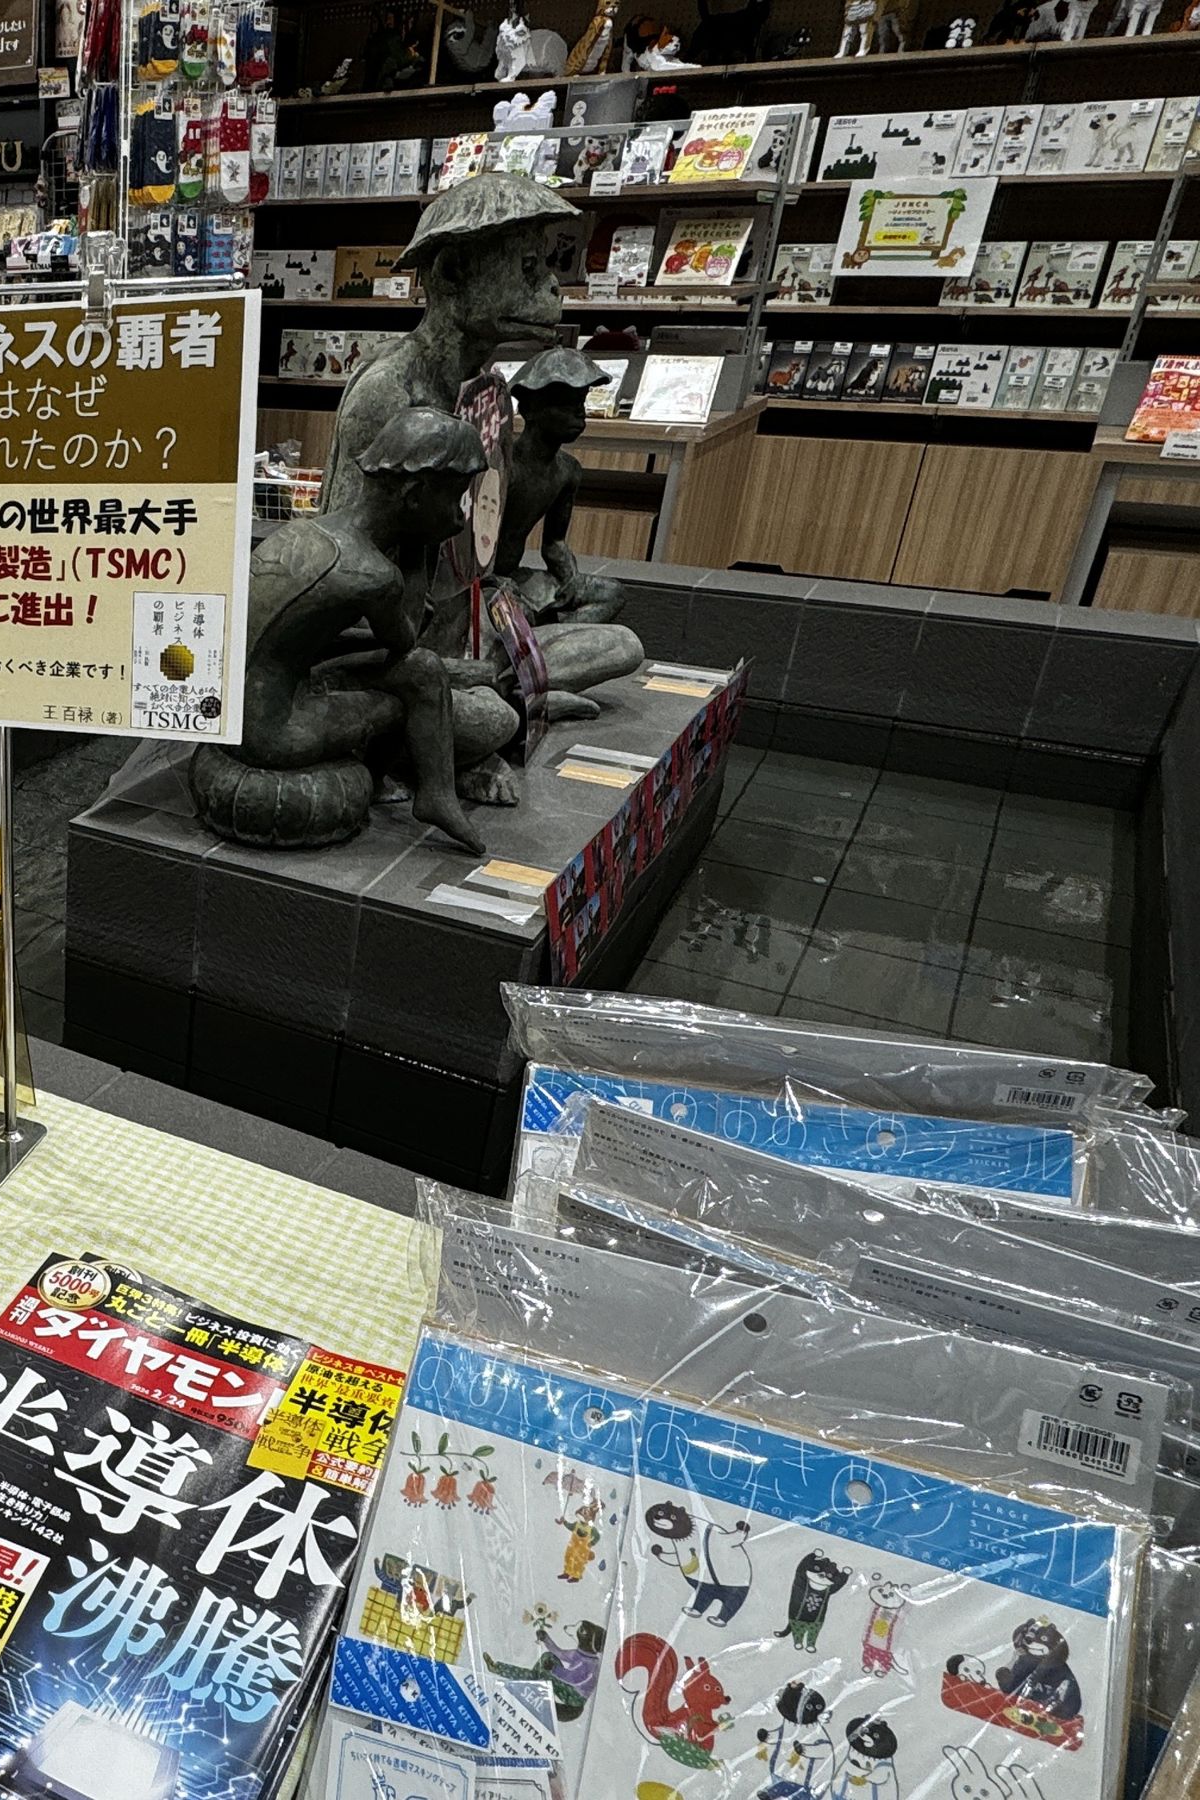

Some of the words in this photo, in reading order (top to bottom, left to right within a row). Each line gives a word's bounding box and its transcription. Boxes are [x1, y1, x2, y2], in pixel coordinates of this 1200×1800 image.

[152, 600, 165, 636] の覇者
[173, 600, 185, 645] ビジネス
[193, 600, 206, 640] 半導体
[143, 710, 209, 732] TSMC
[48, 1271, 101, 1299] 5000号
[67, 1264, 98, 1282] 創刊
[50, 1286, 81, 1305] 記念
[9, 1294, 41, 1326] 週刊
[104, 1295, 297, 1378] 丸ごと一冊「半導体」
[185, 1311, 301, 1361] ビジネス・投資に効く
[305, 1363, 384, 1393] 原油を超える
[151, 1387, 186, 1410] 2/24
[322, 1426, 387, 1465] 戦争
[971, 1500, 1029, 1523] LARGE
[41, 1541, 305, 1724] 沸騰
[345, 1649, 363, 1676] KITTA
[343, 1672, 361, 1698] KITTA
[362, 1678, 380, 1704] KITTA
[419, 1669, 439, 1697] KITTA
[438, 1675, 458, 1703] KITTA
[438, 1699, 457, 1728] KITTA
[457, 1704, 478, 1733] KITTA
[494, 1692, 516, 1718] KITTA
[497, 1716, 521, 1743] KITTA
[518, 1717, 543, 1744] KITTA
